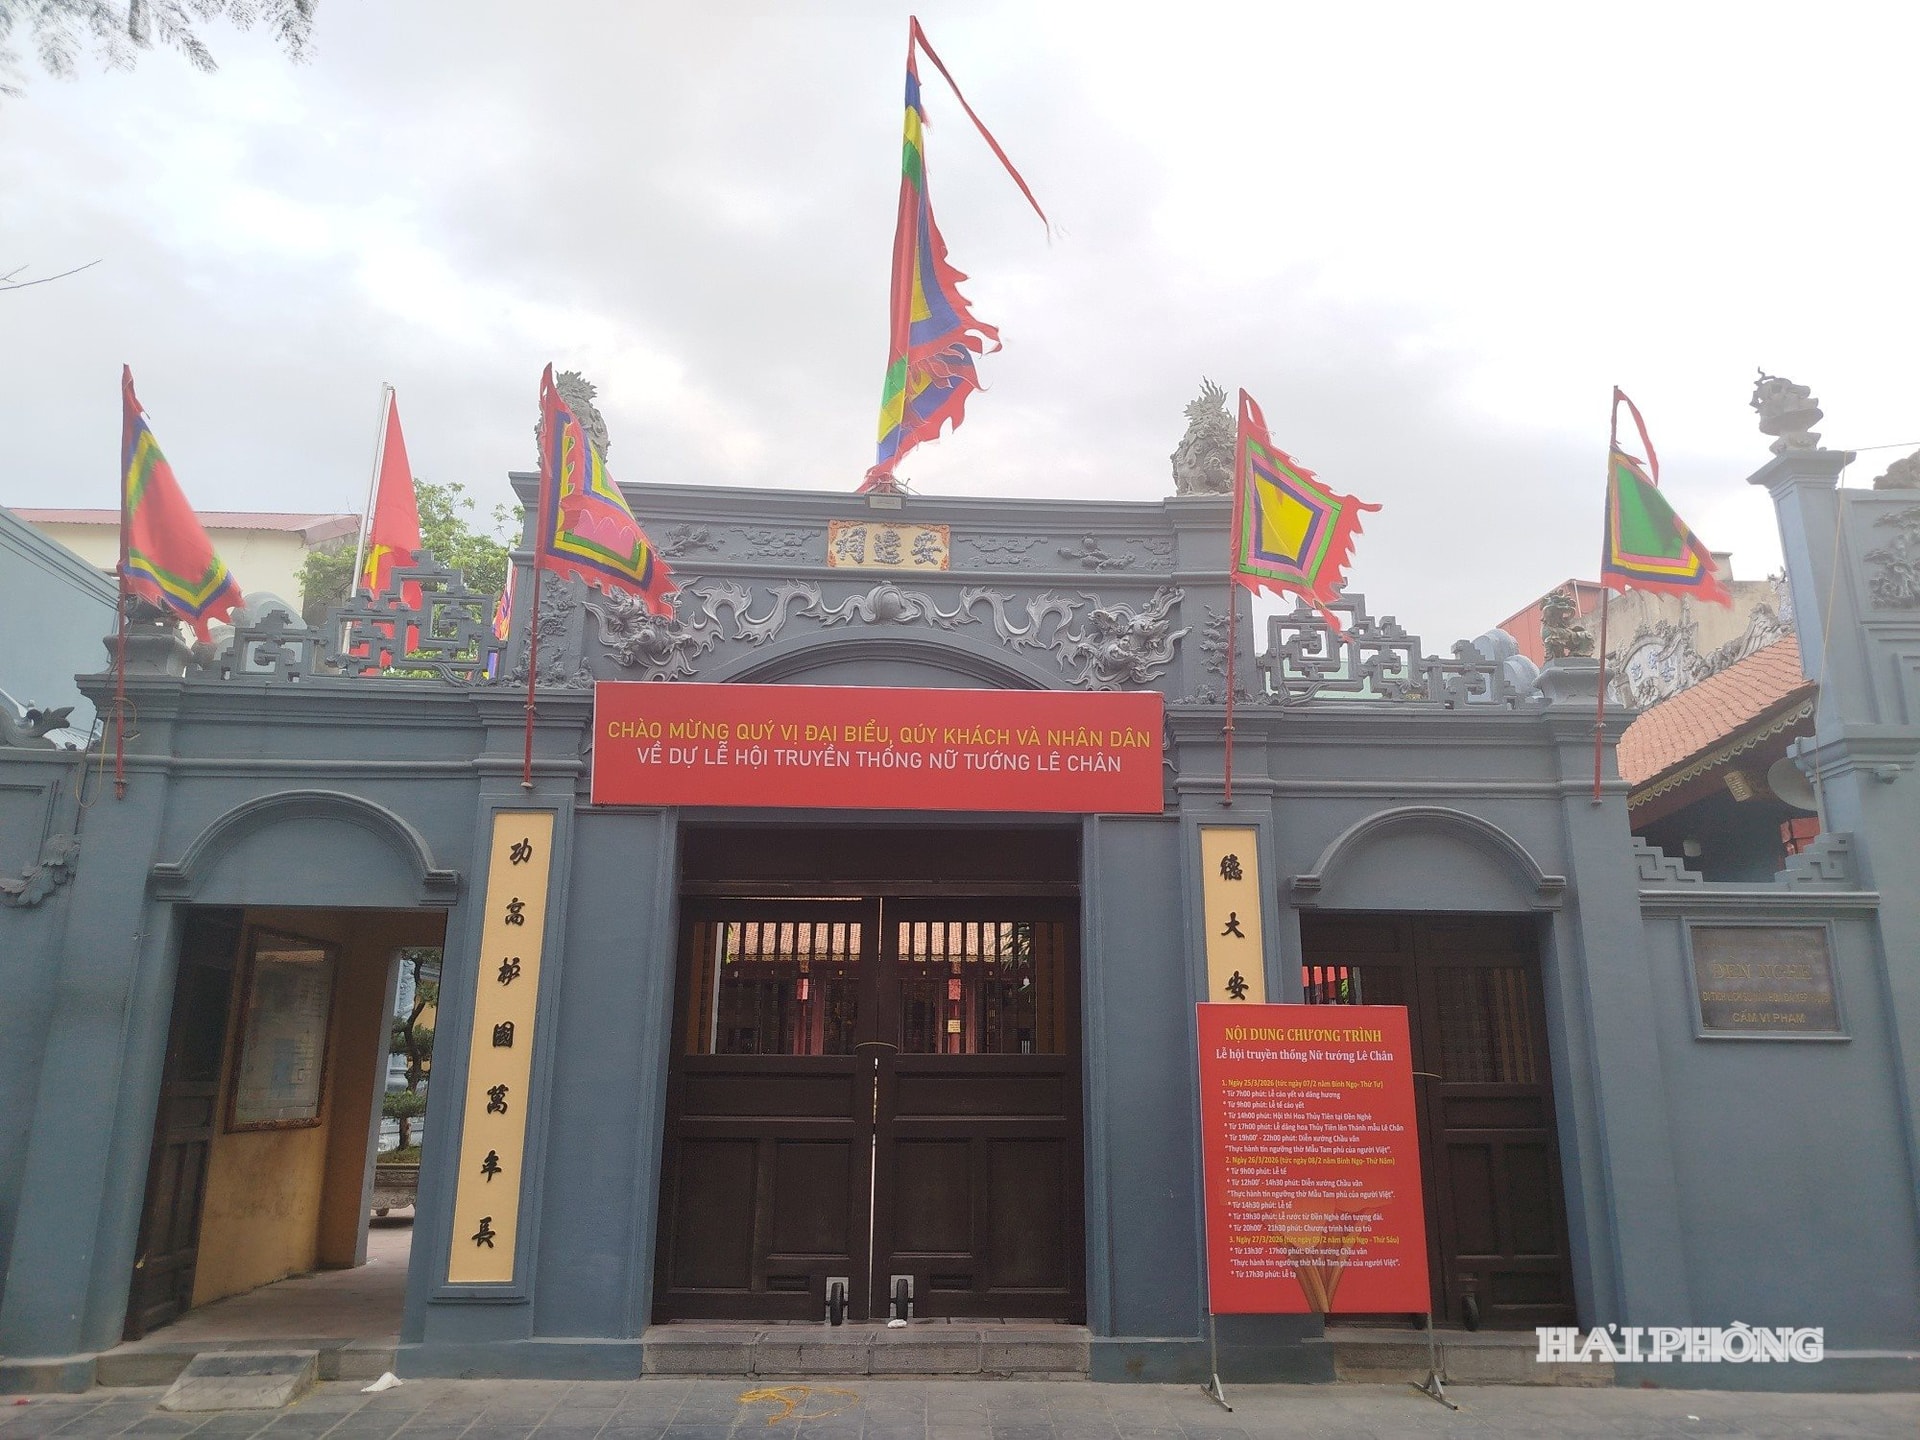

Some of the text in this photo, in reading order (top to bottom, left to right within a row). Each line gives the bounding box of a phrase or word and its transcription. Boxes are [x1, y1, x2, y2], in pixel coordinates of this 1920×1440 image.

[608, 718, 1150, 748] CHÀO MỪNG QUÝ VỊ ĐẠI BIỂU, QÚY KHÁCH VÀ NHÂN DÂN
[636, 740, 1121, 772] VỀ DỰ LỄ HỘI TRUYỀN THỐNG NỮ TƯỚNG LÊ CHÂN
[1225, 1024, 1382, 1043] NỘI DUNG CHƯƠNG TRÌNH
[1216, 1046, 1393, 1064] Lễ hội truyền thống Nữ tướng Lê Chân
